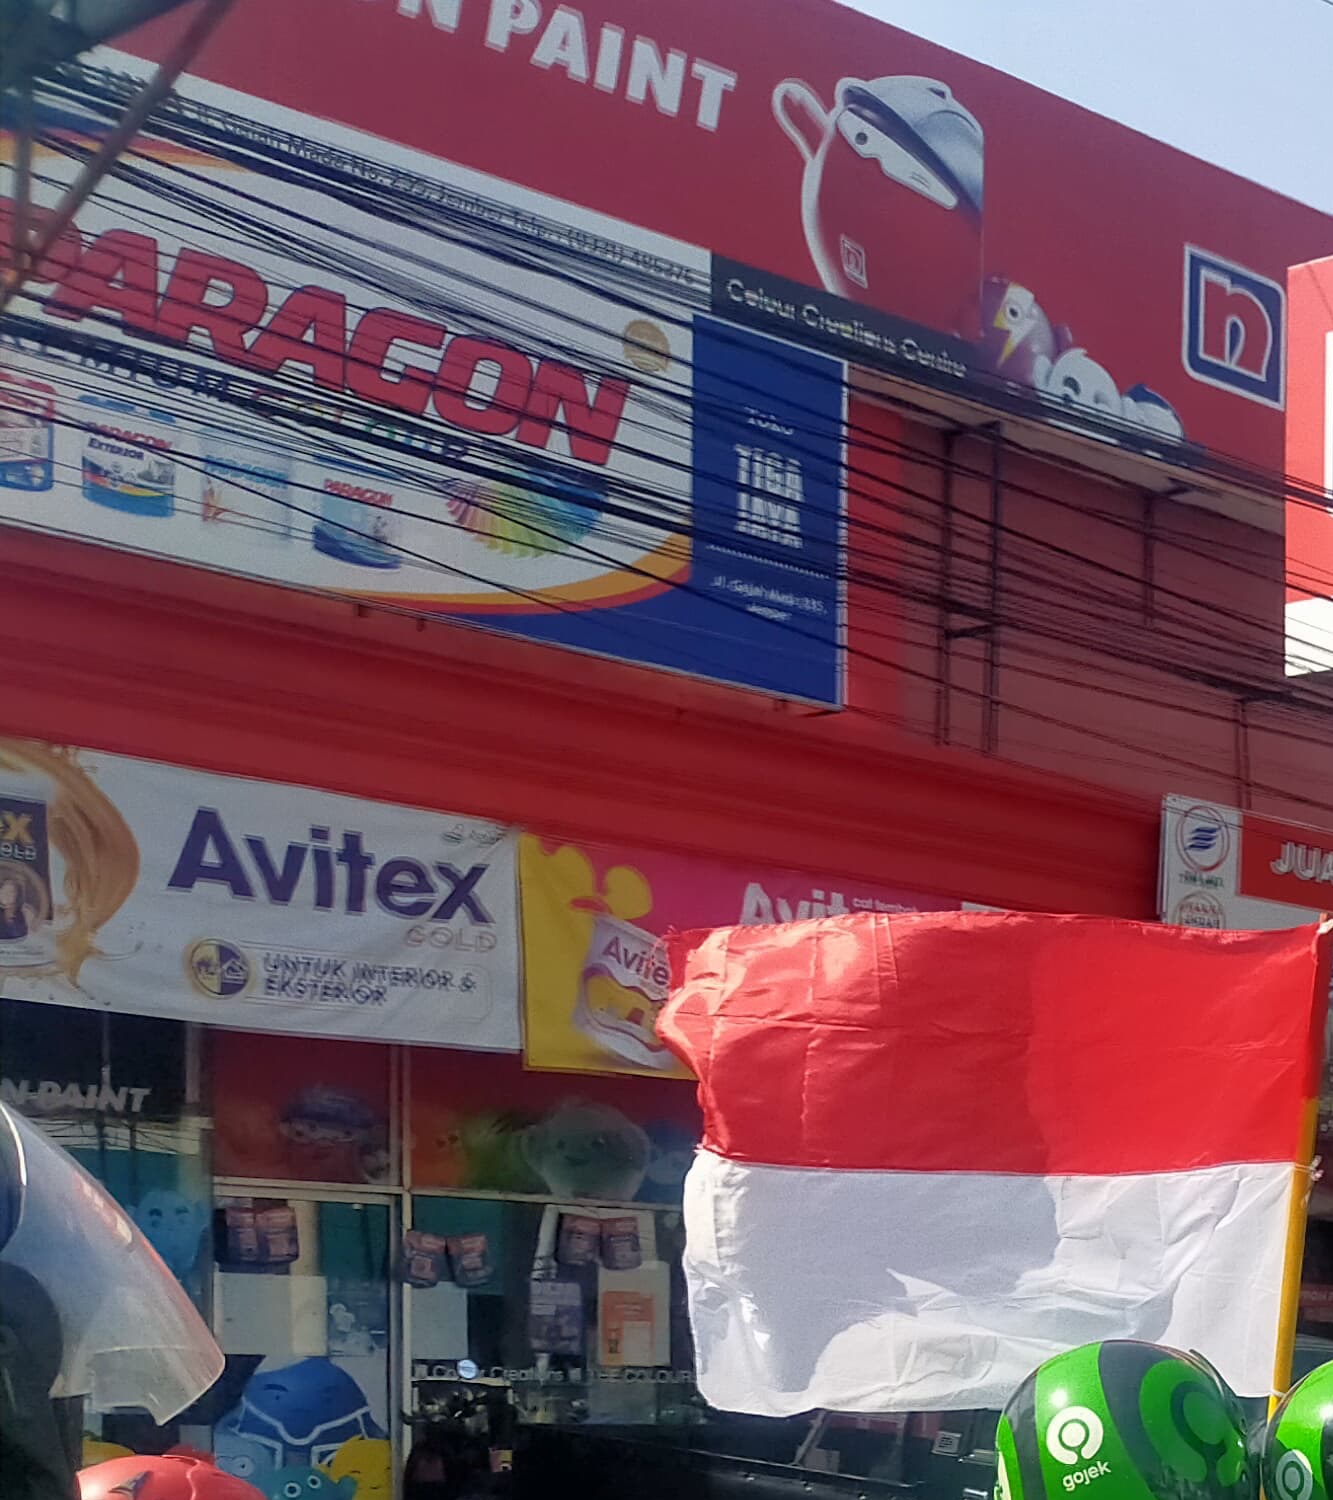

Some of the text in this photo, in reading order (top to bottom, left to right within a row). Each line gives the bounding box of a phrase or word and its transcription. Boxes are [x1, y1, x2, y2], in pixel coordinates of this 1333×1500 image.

[485, 0, 738, 132] PAINT
[165, 804, 497, 926] Avitex
[404, 926, 498, 953] GOLD
[262, 951, 346, 980] UNTUK
[351, 958, 455, 991] INTERIOR
[602, 936, 673, 986] Avite
[263, 976, 388, 1007] EKSTERIOR
[1062, 1461, 1113, 1492] gojek
